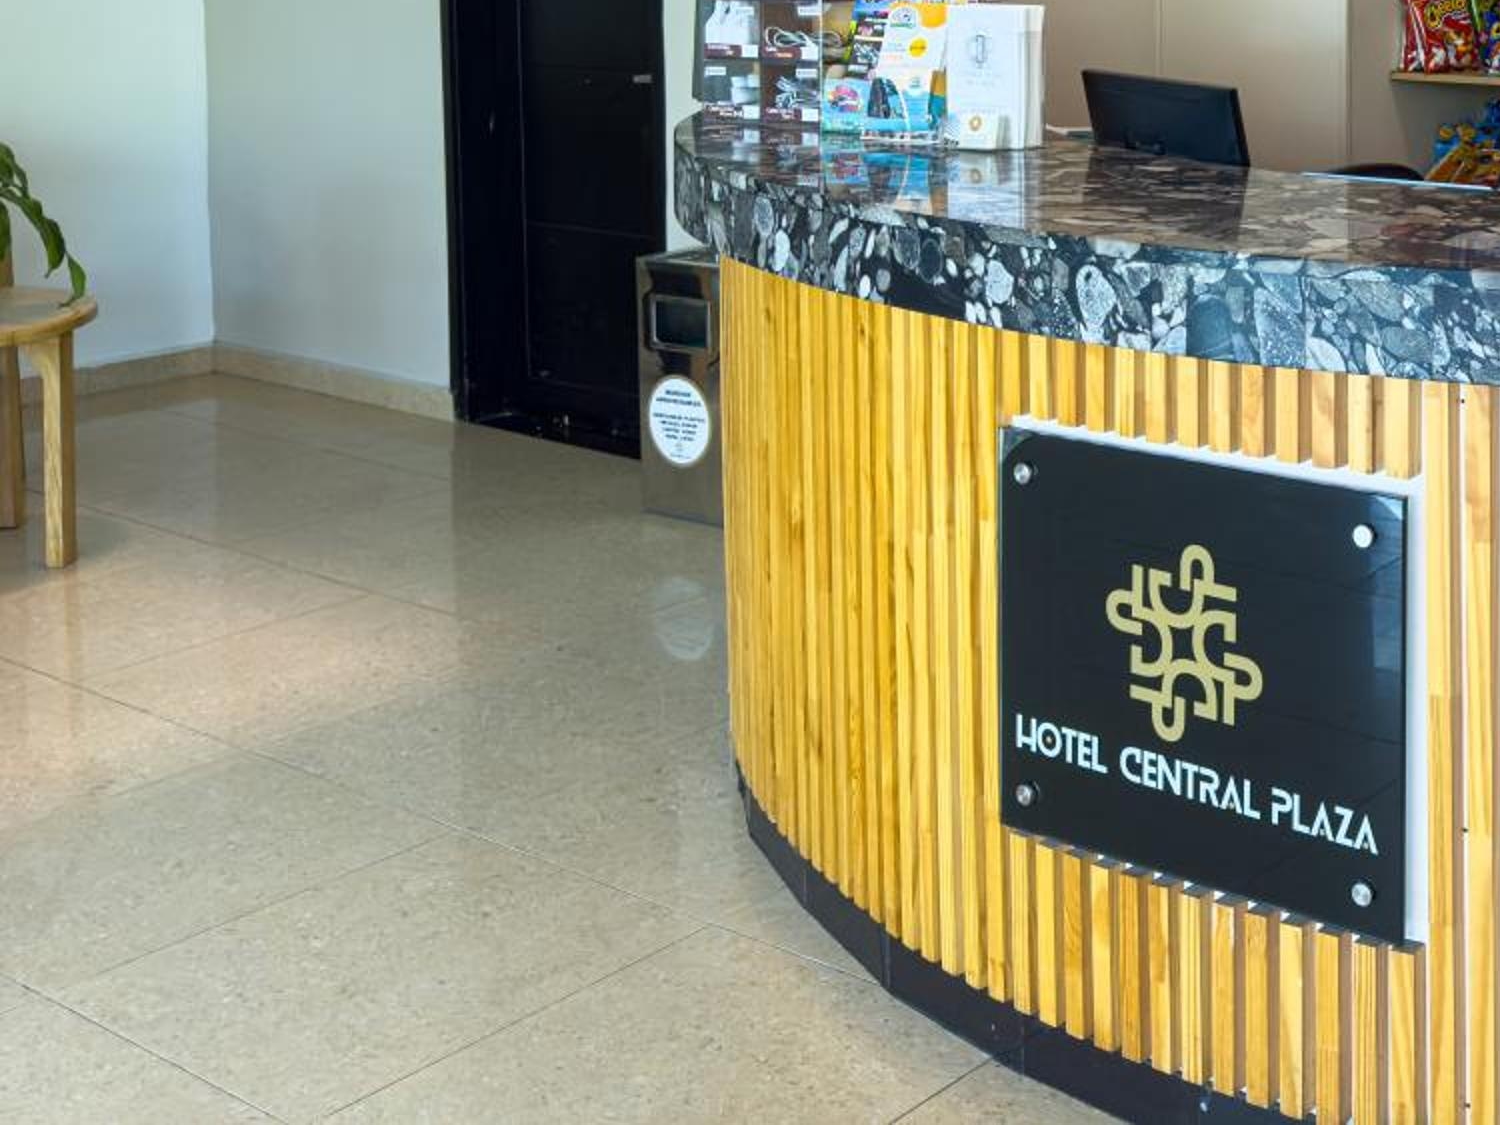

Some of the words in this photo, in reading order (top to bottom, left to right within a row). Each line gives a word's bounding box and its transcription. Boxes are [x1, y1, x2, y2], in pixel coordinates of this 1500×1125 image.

[1015, 713, 1108, 775] HOTEL
[1118, 746, 1261, 821] CENTRAL
[1270, 787, 1379, 856] PLAZA
